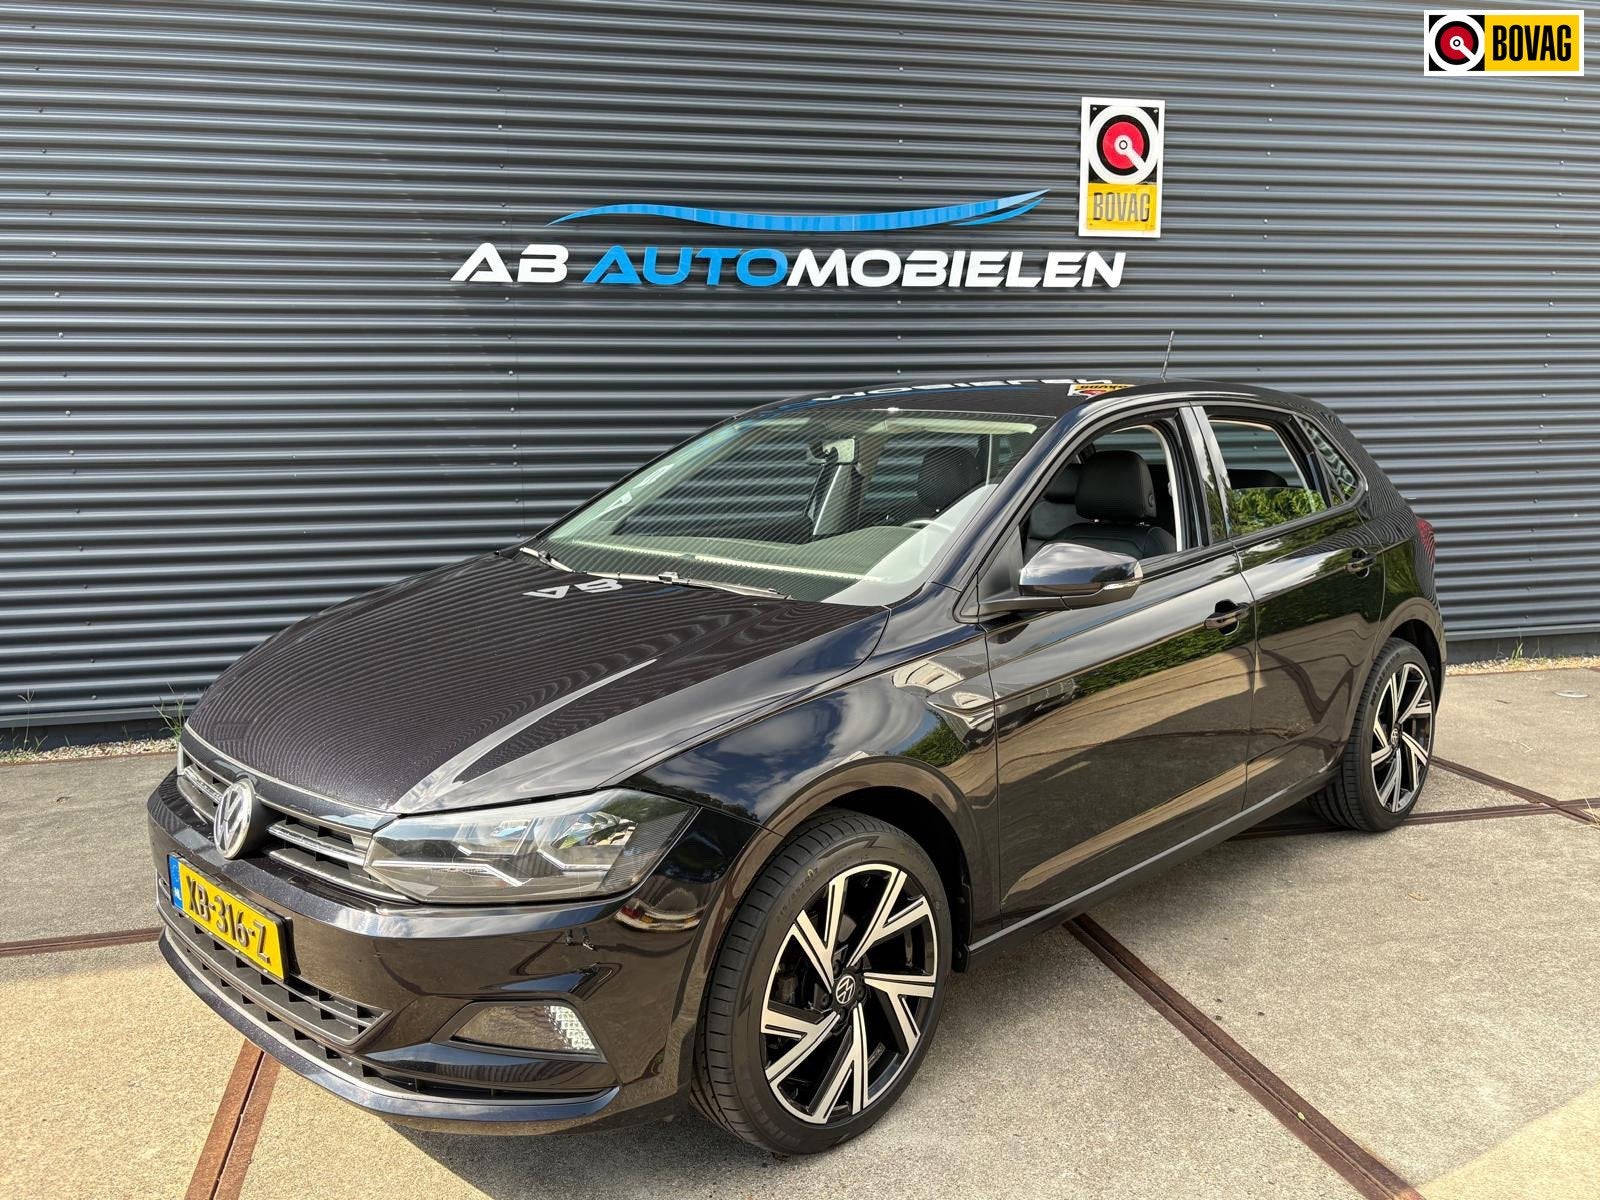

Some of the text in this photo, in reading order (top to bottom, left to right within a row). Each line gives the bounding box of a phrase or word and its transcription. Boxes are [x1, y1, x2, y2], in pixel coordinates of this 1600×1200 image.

[1092, 191, 1151, 222] BOVAG
[450, 241, 1126, 288] AB AUTOMOBIELEN
[185, 875, 272, 965] XB-316-Z
